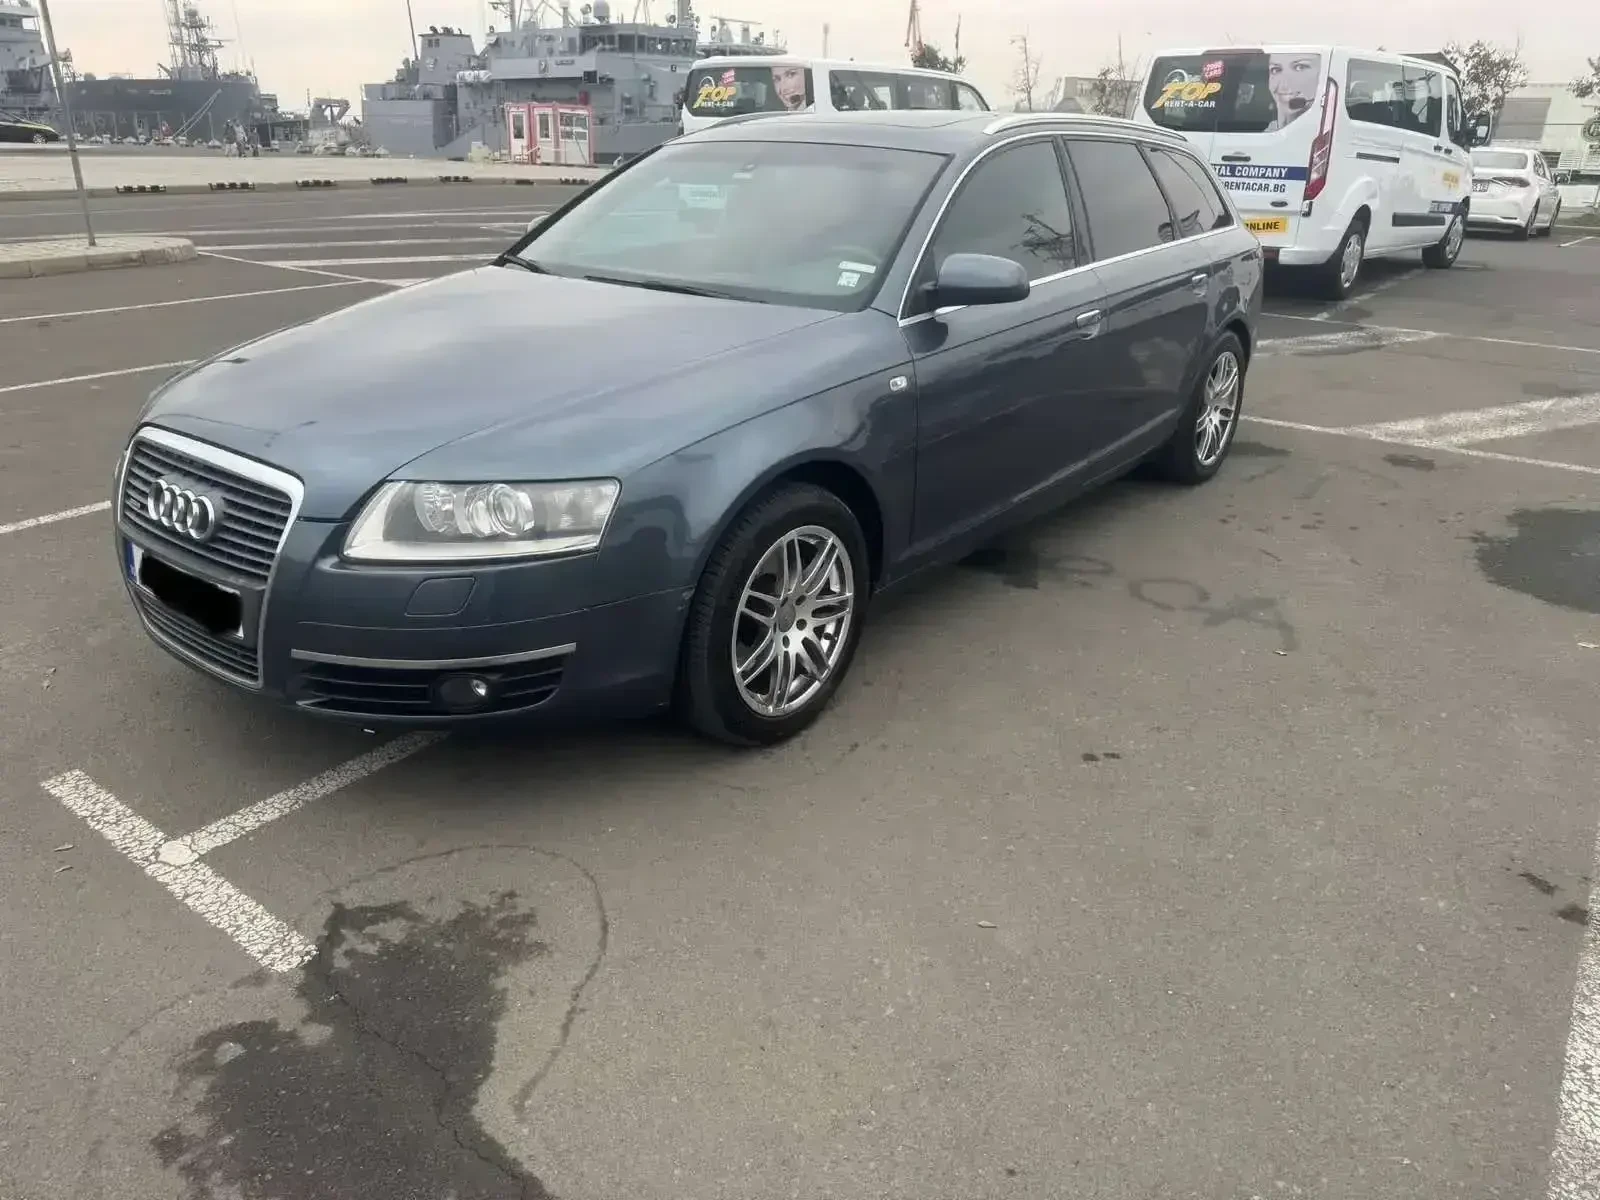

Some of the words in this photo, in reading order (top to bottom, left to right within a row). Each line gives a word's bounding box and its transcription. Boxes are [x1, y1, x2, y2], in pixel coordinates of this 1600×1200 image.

[692, 86, 737, 109] TOP
[1151, 81, 1222, 109] TOP
[1164, 100, 1216, 108] RENT-A-CAR
[1235, 166, 1288, 178] COMPANY
[1222, 181, 1286, 193] RENTACAR.BG
